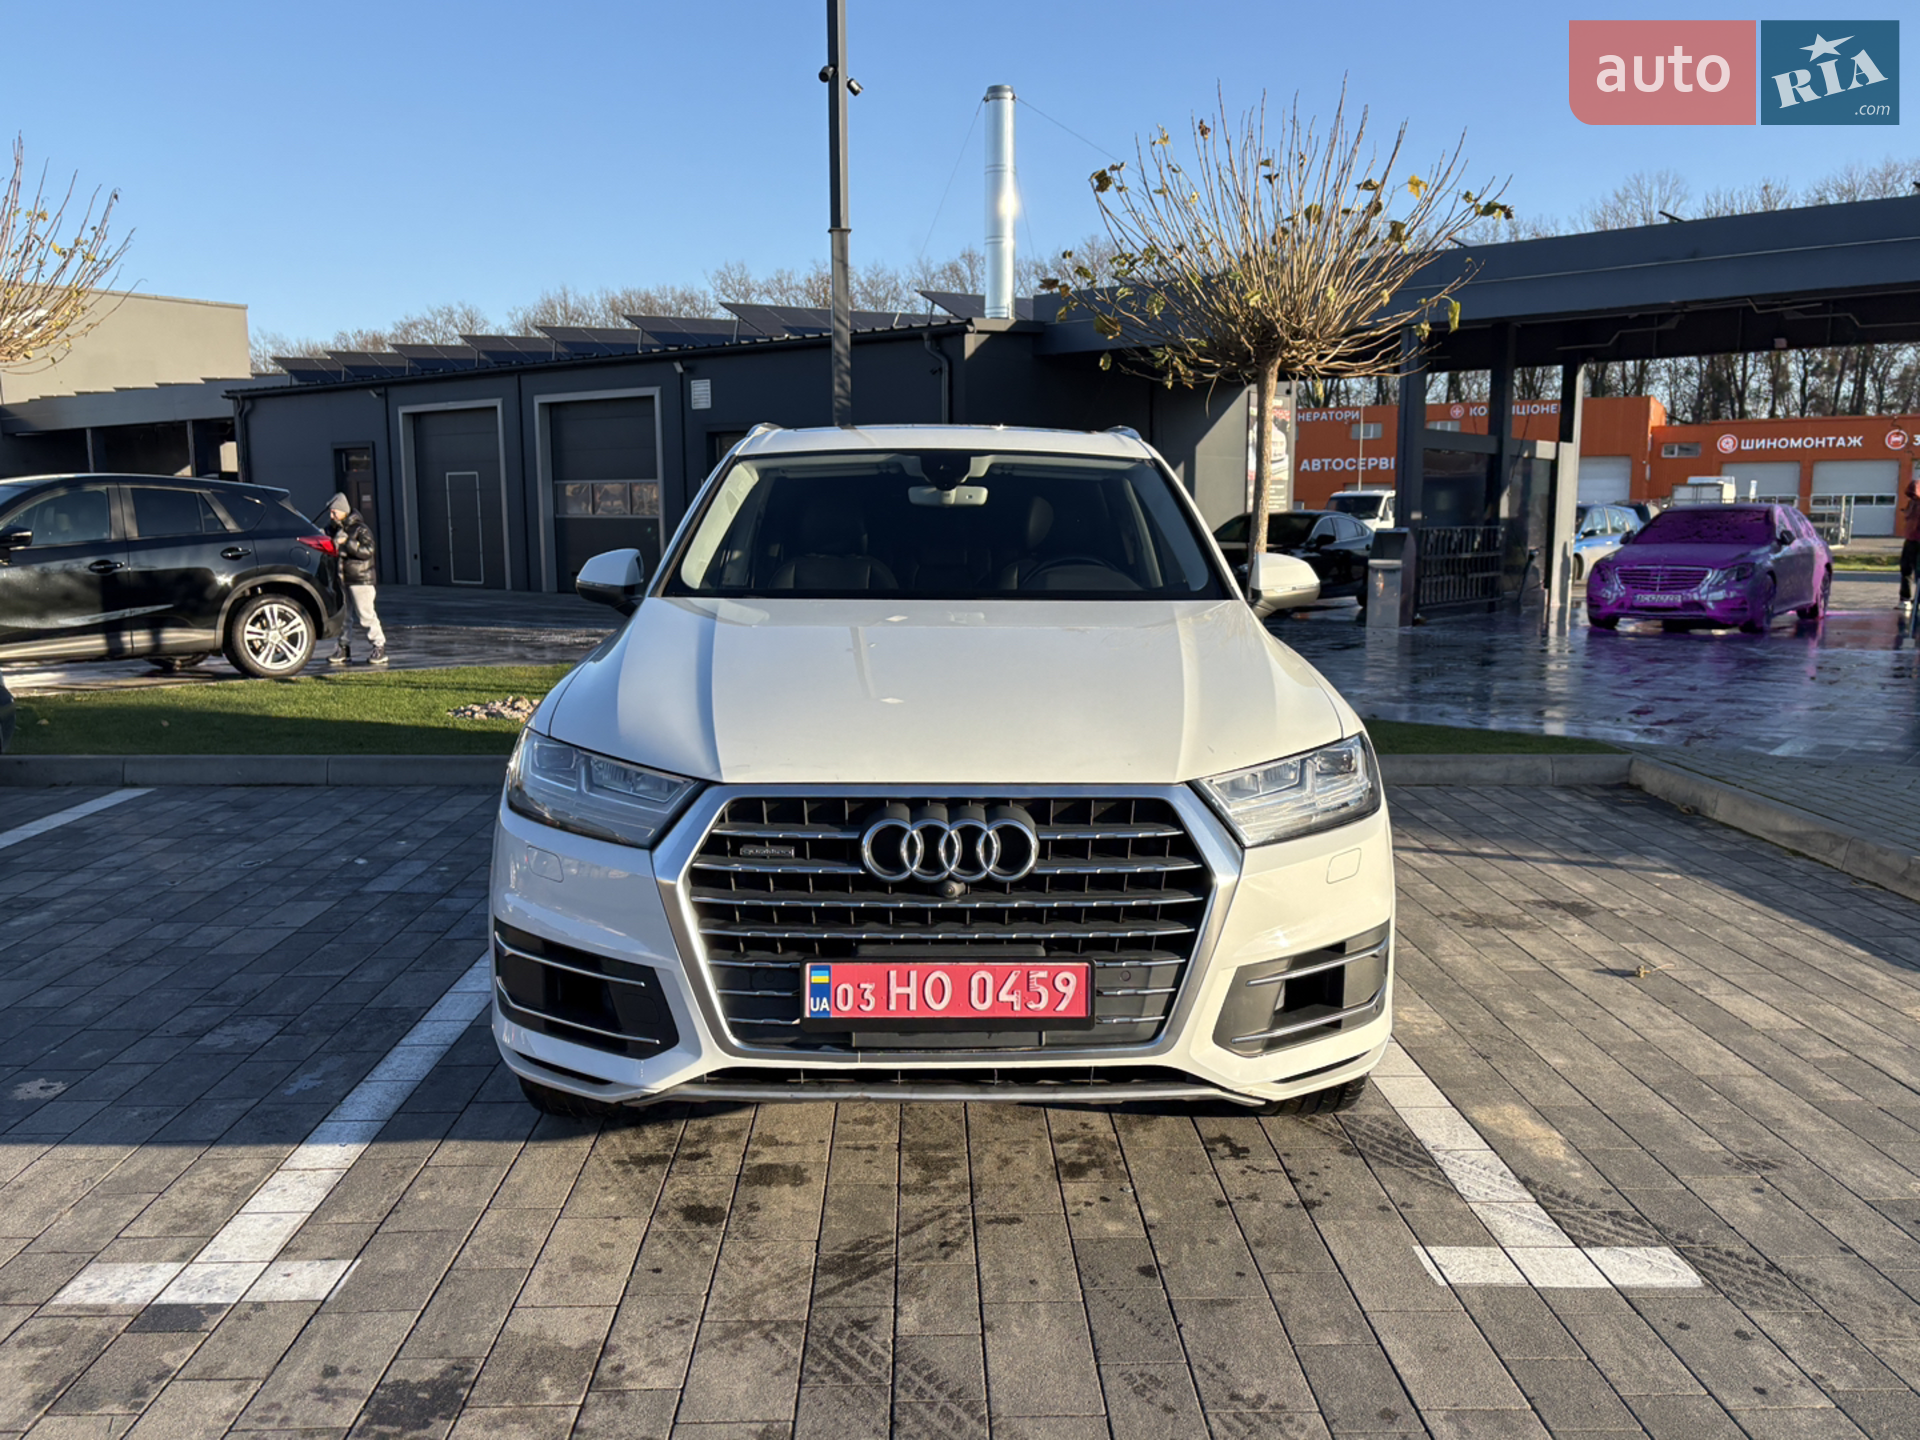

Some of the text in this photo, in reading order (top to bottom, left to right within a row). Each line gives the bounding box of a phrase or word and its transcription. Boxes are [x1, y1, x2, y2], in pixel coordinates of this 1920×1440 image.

[1297, 410, 1360, 422] НЕРАТОРИ
[1740, 435, 1864, 451] ШИНОМОНТАЖ
[1299, 456, 1395, 472] АВТОСЕРВІ
[834, 970, 1078, 1012] 03 HO 0459
[810, 997, 830, 1012] UA
